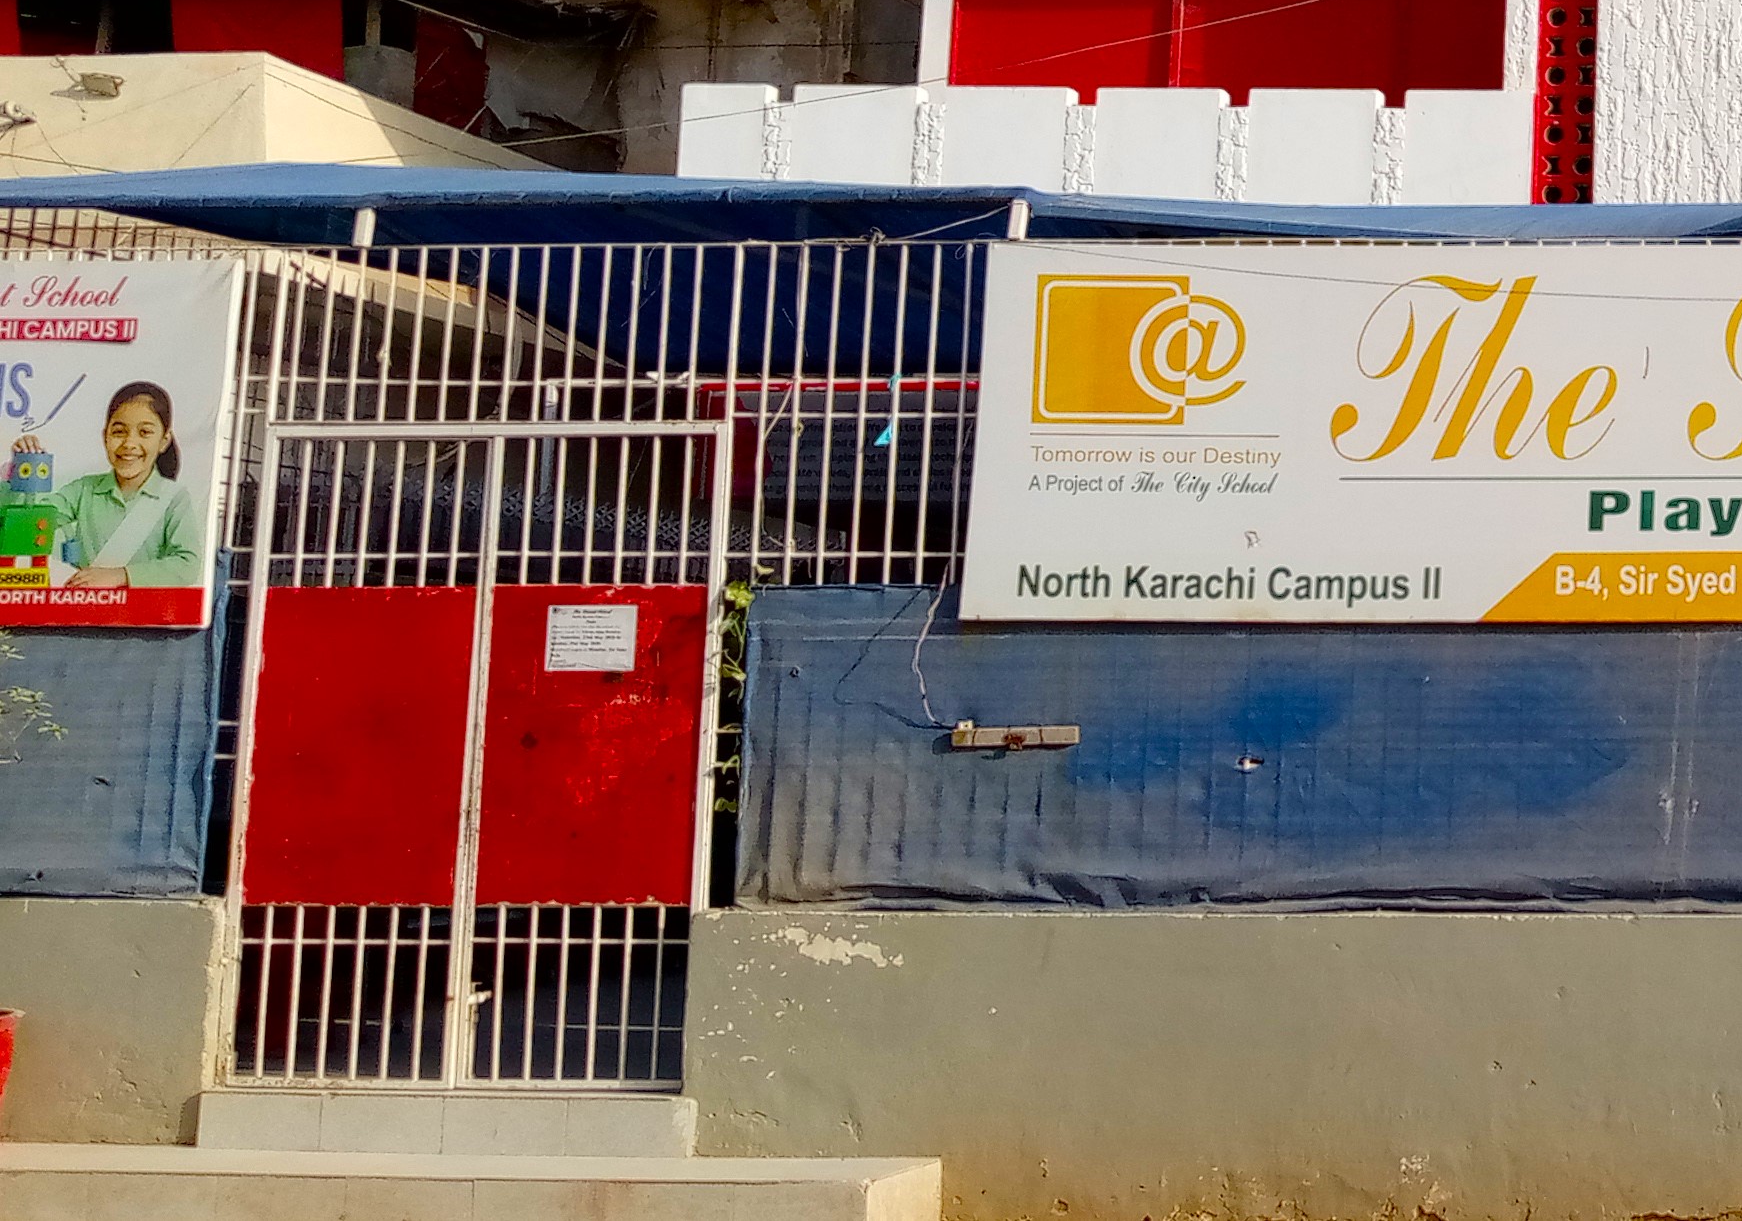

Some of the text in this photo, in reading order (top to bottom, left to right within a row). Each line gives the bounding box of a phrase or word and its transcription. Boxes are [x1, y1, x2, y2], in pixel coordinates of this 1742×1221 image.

[23, 275, 129, 308] School
[24, 320, 118, 339] CAMPUS
[123, 320, 135, 338] II
[1330, 275, 1618, 461] The
[1030, 445, 1282, 468] Tomorrow is our Destiny
[1028, 471, 1279, 502] A Project of The City School
[49, 589, 128, 604] KARACHI
[1016, 564, 1441, 608] North Karachi Campus II
[1555, 565, 1609, 600] B-4,
[1619, 565, 1659, 595] Sir
[1666, 564, 1737, 602] Syed
